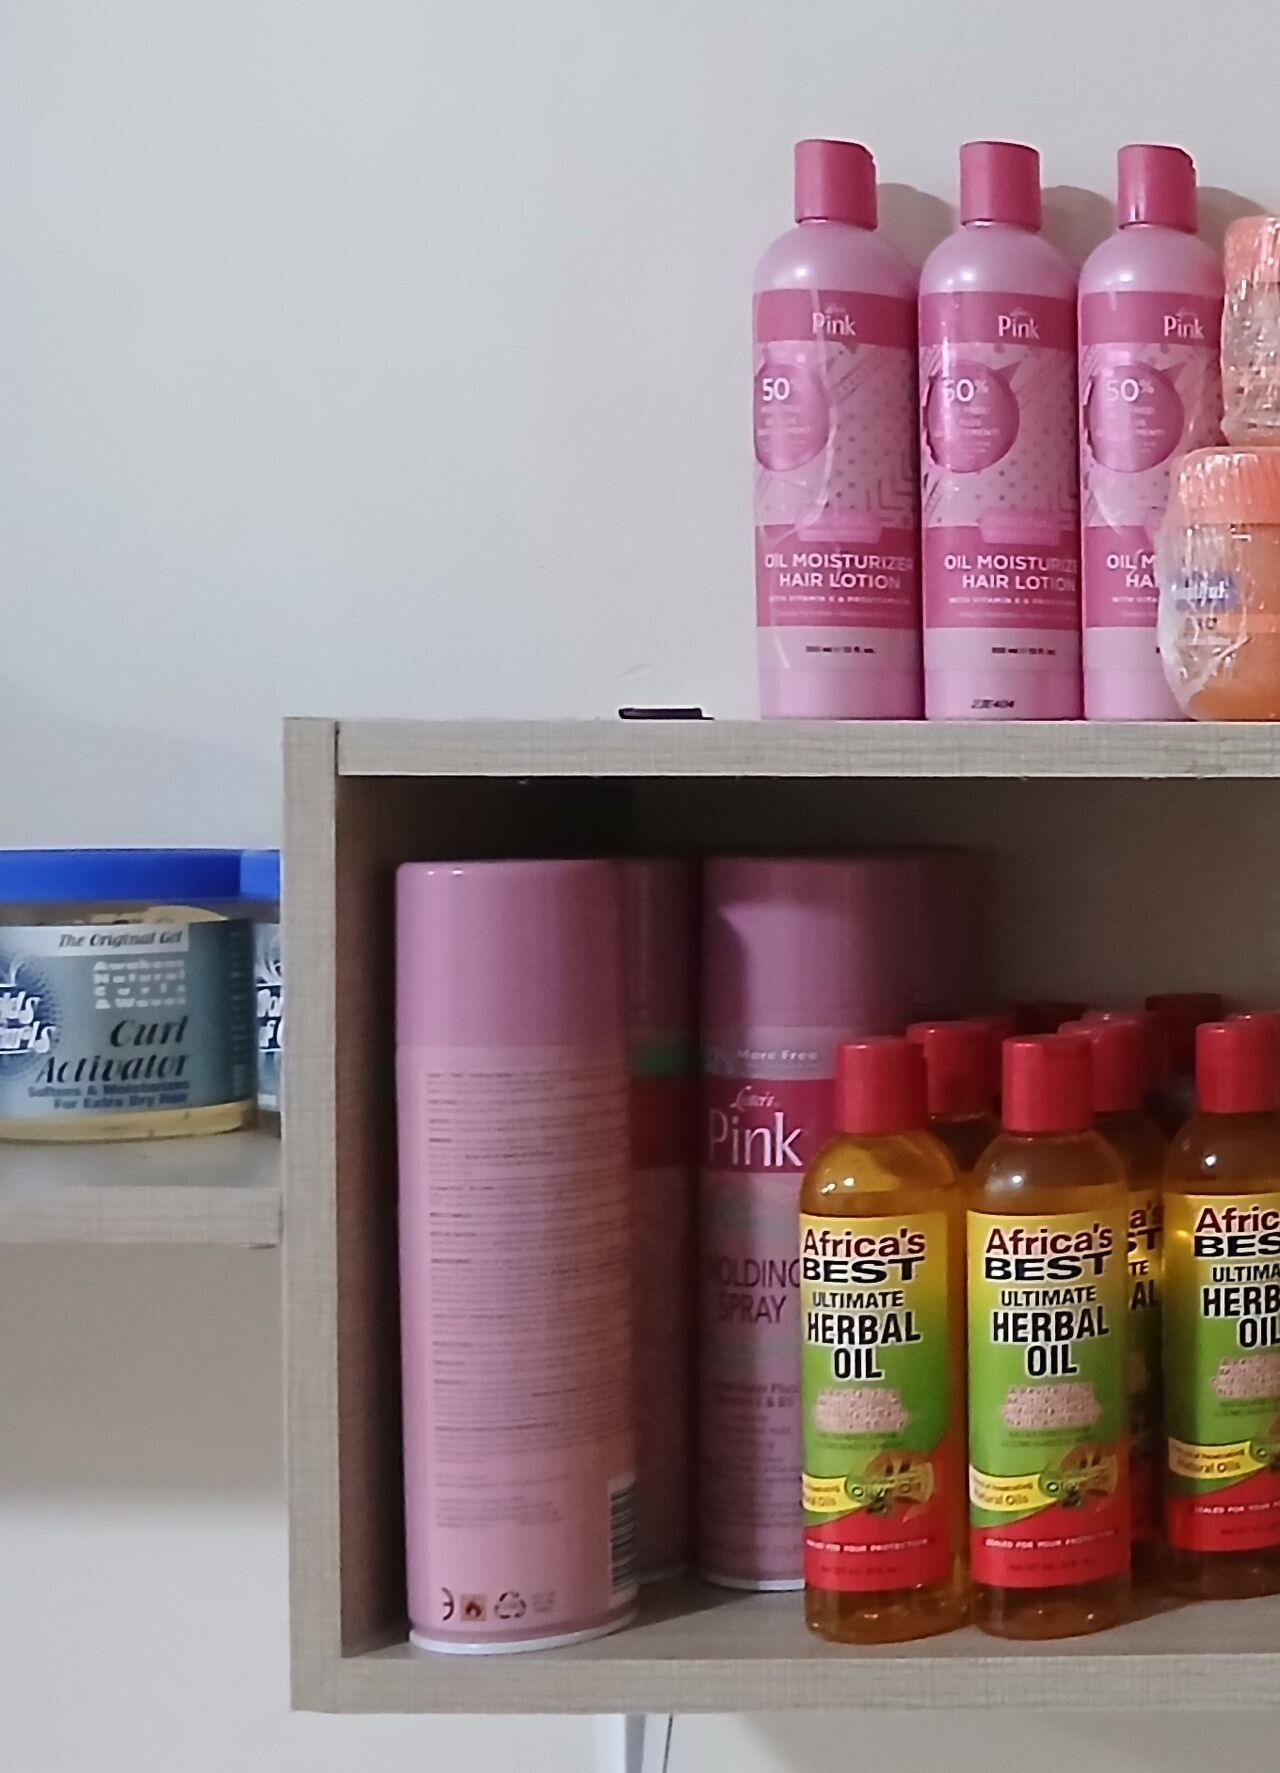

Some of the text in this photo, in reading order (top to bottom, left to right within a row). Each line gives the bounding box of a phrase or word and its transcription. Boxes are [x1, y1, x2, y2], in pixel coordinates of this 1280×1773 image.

[812, 312, 856, 336] Pink
[999, 315, 1040, 340] Pink
[1164, 315, 1204, 340] Pink
[765, 554, 788, 568] OIL
[944, 554, 972, 570] OIL
[1106, 554, 1136, 569] OIL
[779, 572, 900, 590] HAIR LOTION
[962, 575, 1076, 592] HAIR LOTION
[89, 932, 155, 948] Original
[110, 1016, 189, 1048] Curl
[782, 1050, 818, 1061] Free
[36, 1055, 189, 1084] Activator
[709, 1110, 803, 1167] Pink
[803, 1228, 925, 1257] Africa's
[986, 1223, 1112, 1256] Africa's
[803, 1256, 926, 1284] BEST
[985, 1250, 1112, 1281] BEST
[813, 1290, 904, 1309] ULTIMATE
[1001, 1286, 1097, 1307] ULTIMATE
[808, 1311, 921, 1345] HERBAL
[993, 1305, 1109, 1343] HERBAL
[834, 1347, 882, 1379] OIL
[1027, 1344, 1077, 1376] OIL
